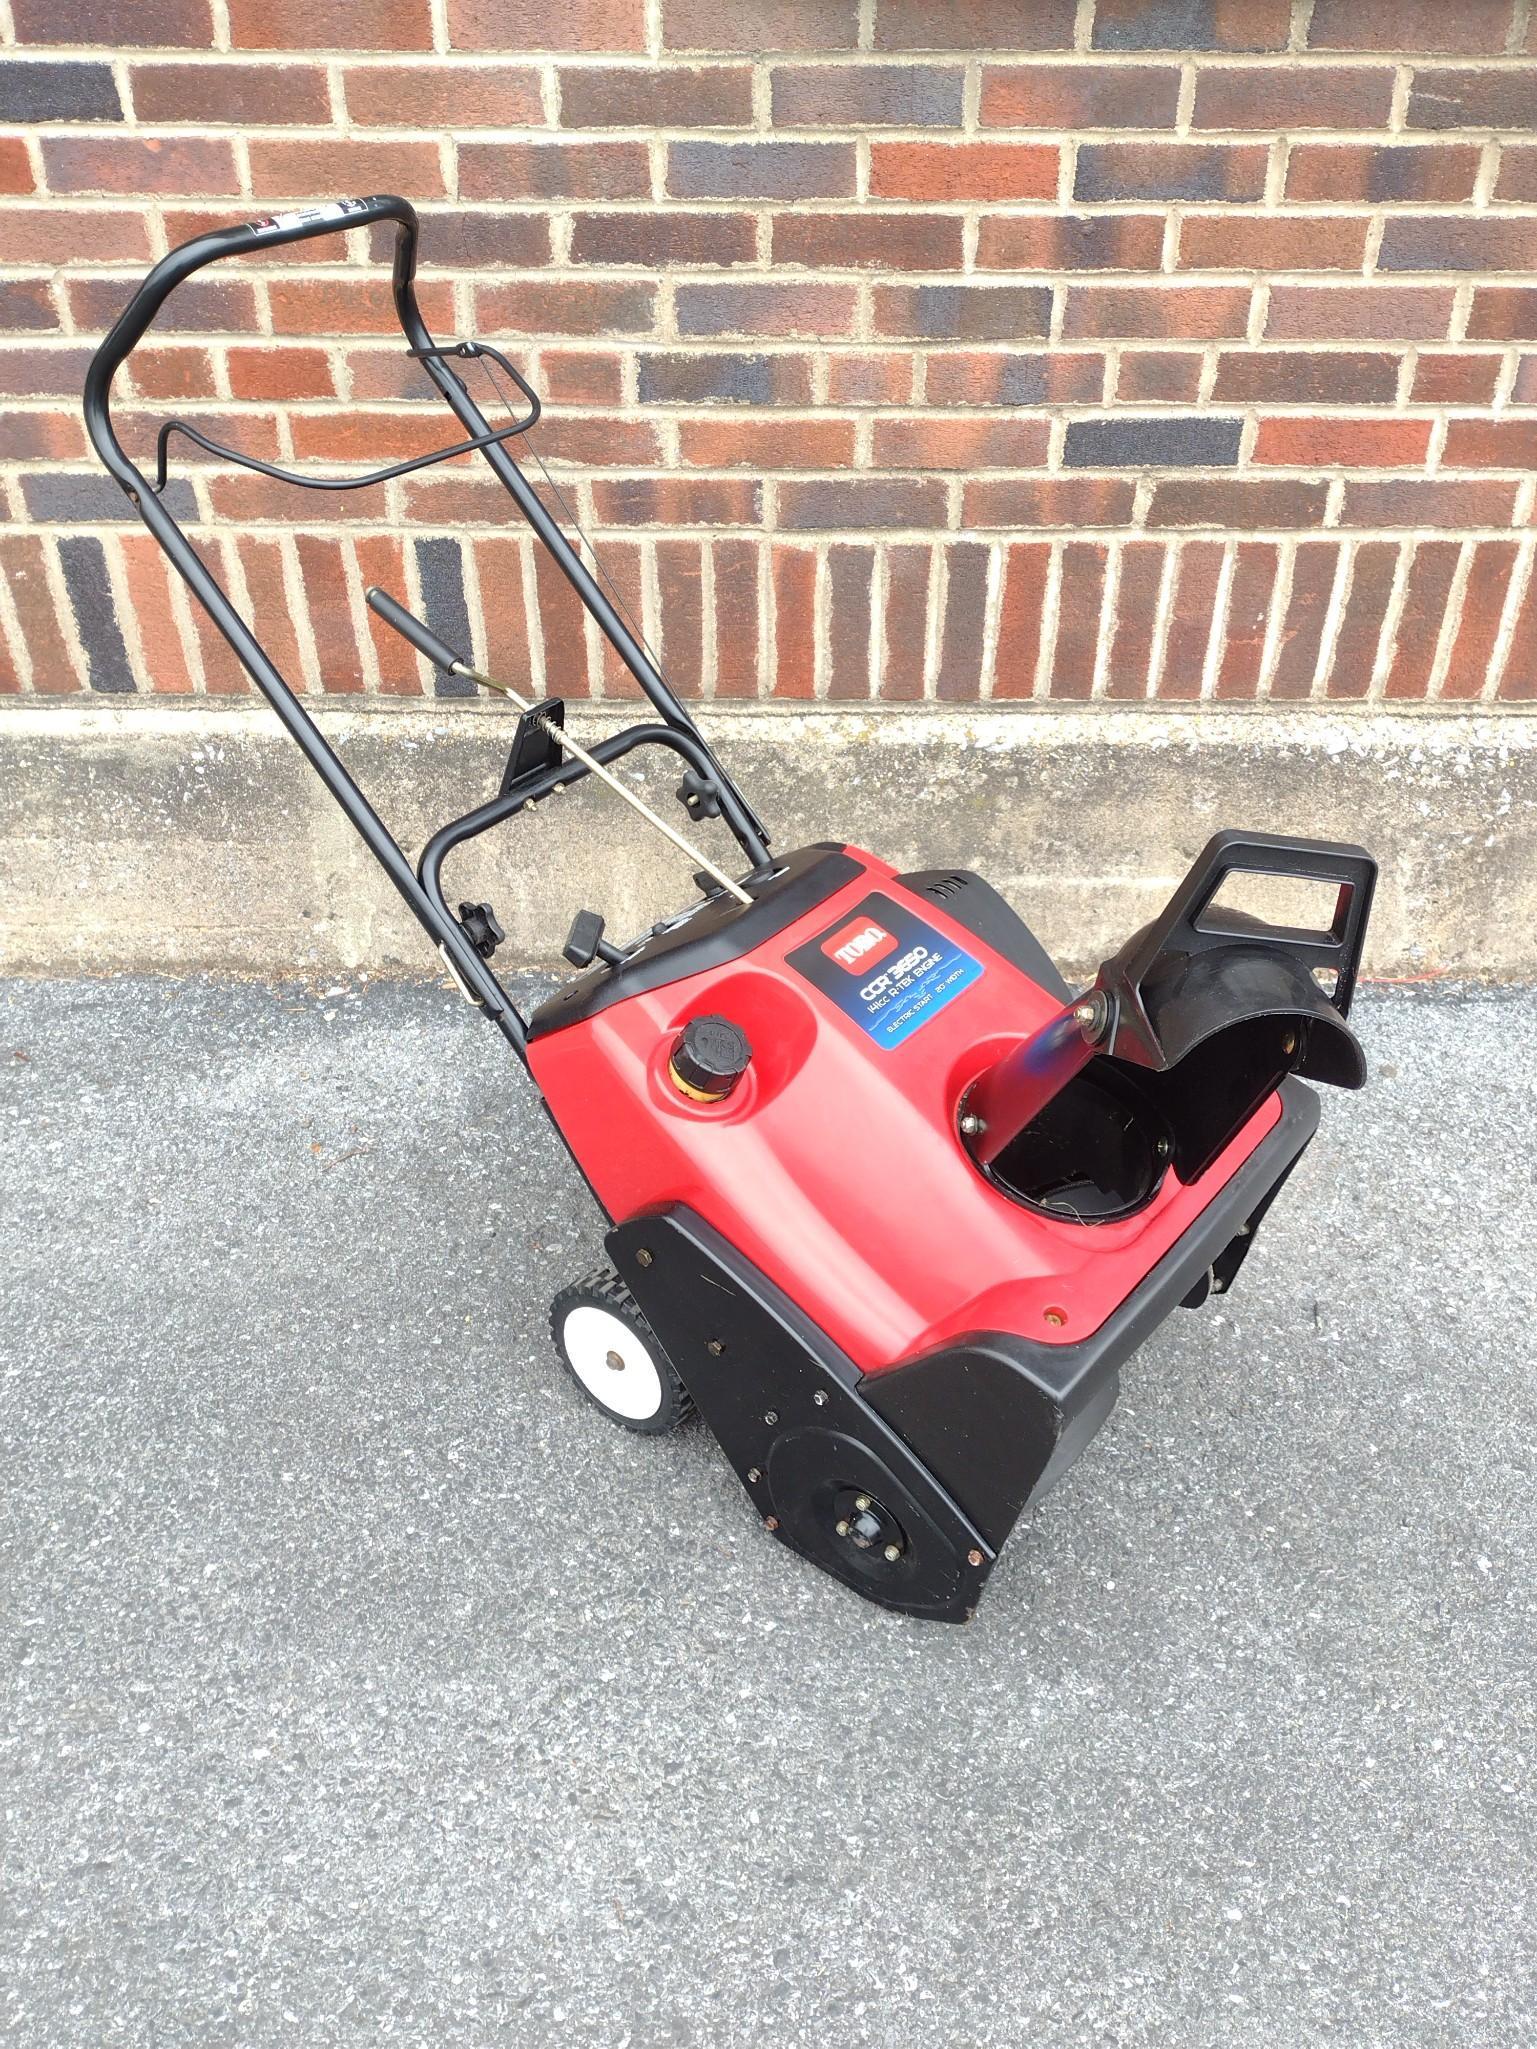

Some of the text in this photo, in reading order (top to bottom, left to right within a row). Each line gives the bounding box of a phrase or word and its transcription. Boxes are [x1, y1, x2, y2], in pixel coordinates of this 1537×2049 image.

[834, 927, 887, 965] TORO
[912, 952, 943, 977] ENGINE
[860, 946, 928, 1001] CCR 3650
[886, 1009, 915, 1033] ELECTRIC
[913, 993, 933, 1011] START
[945, 968, 965, 985] WIDTH
